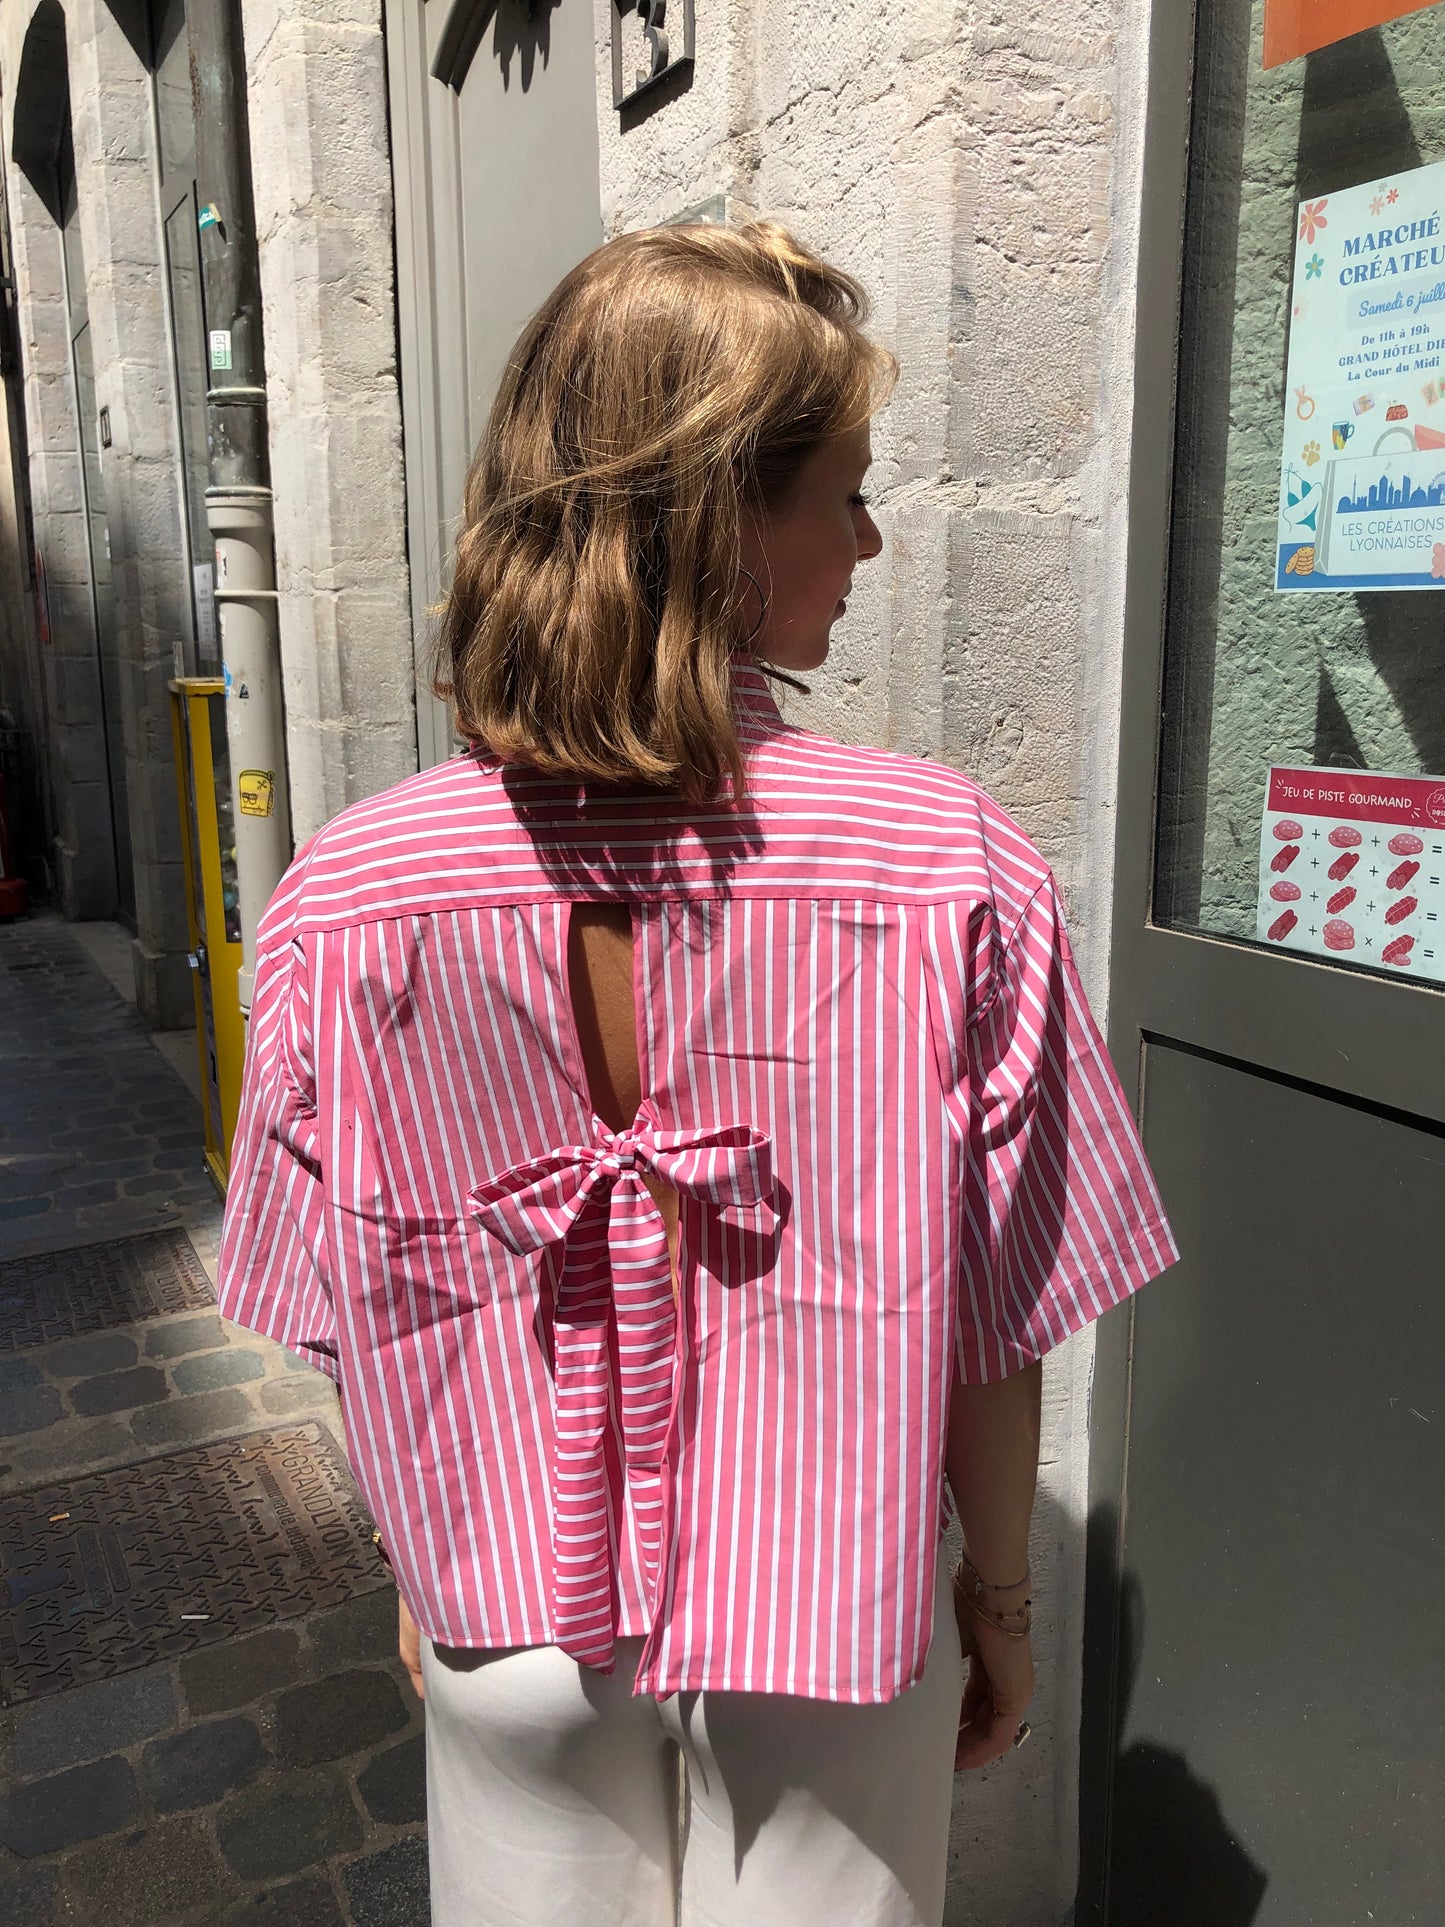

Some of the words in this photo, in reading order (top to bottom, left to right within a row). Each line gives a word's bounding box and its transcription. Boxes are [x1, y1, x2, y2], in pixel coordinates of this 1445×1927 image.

[1342, 209, 1440, 258] MARCHÉ
[1339, 245, 1445, 286] CRÉATEU
[1358, 291, 1405, 317] Samedi
[1406, 294, 1415, 307] 6
[1361, 335, 1375, 346] De
[1379, 331, 1395, 342] 11h
[1399, 328, 1406, 338] à
[1410, 323, 1430, 337] 19h
[1338, 351, 1379, 367] GRAND
[1347, 371, 1361, 381] La
[1364, 367, 1392, 378] Cour
[1395, 362, 1410, 373] du
[1413, 355, 1440, 370] Midi
[1341, 522, 1363, 536] LES
[1367, 516, 1445, 535] CRÉATIONS
[1349, 534, 1433, 552] LYONNAISES
[1282, 786, 1300, 798] JEU
[1303, 788, 1315, 800] DE
[1318, 789, 1345, 803] PISTE
[1348, 793, 1412, 809] GOURMAND
[254, 1463, 301, 1527] communauté
[285, 1526, 318, 1570] urbaine
